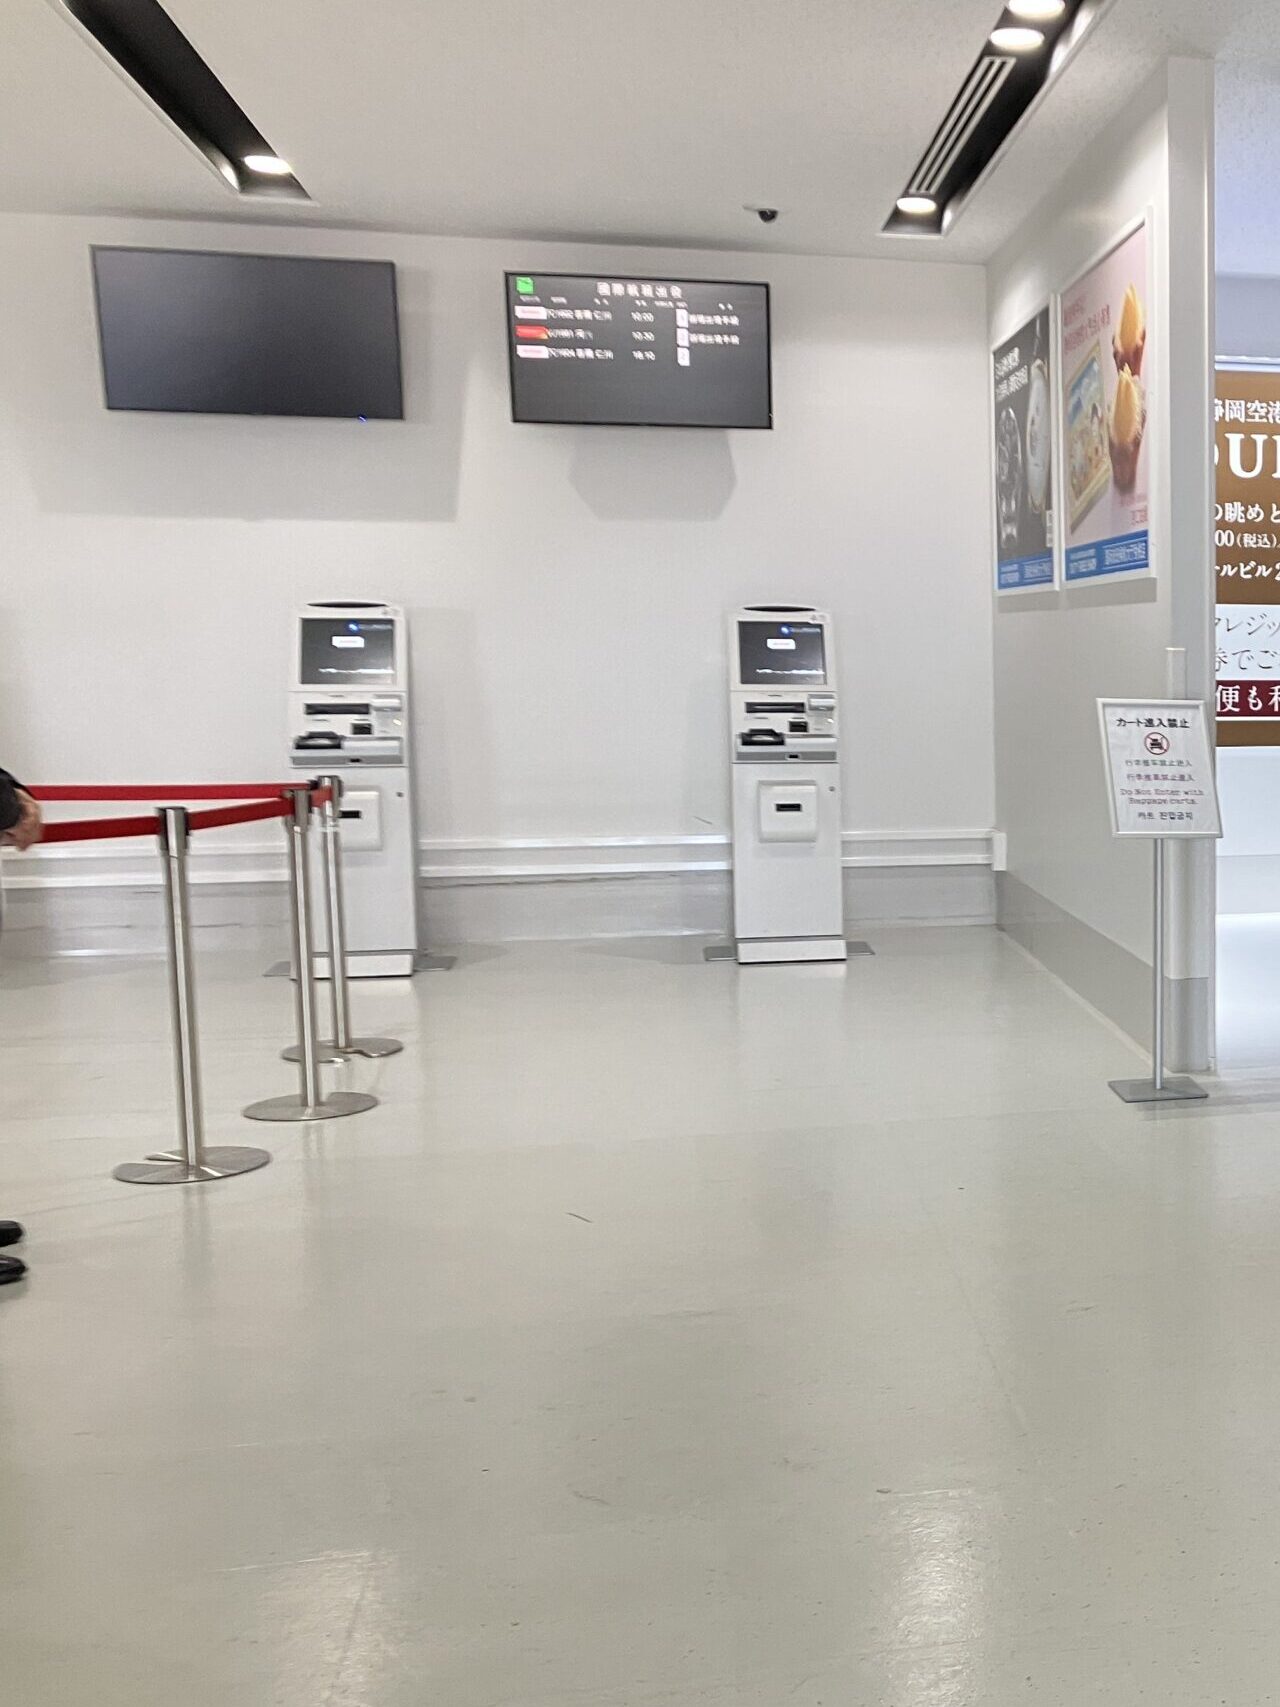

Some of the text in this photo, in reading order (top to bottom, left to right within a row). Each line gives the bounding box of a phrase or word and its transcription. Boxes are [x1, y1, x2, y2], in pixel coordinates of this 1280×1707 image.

[1116, 717, 1190, 729] カート進入禁止
